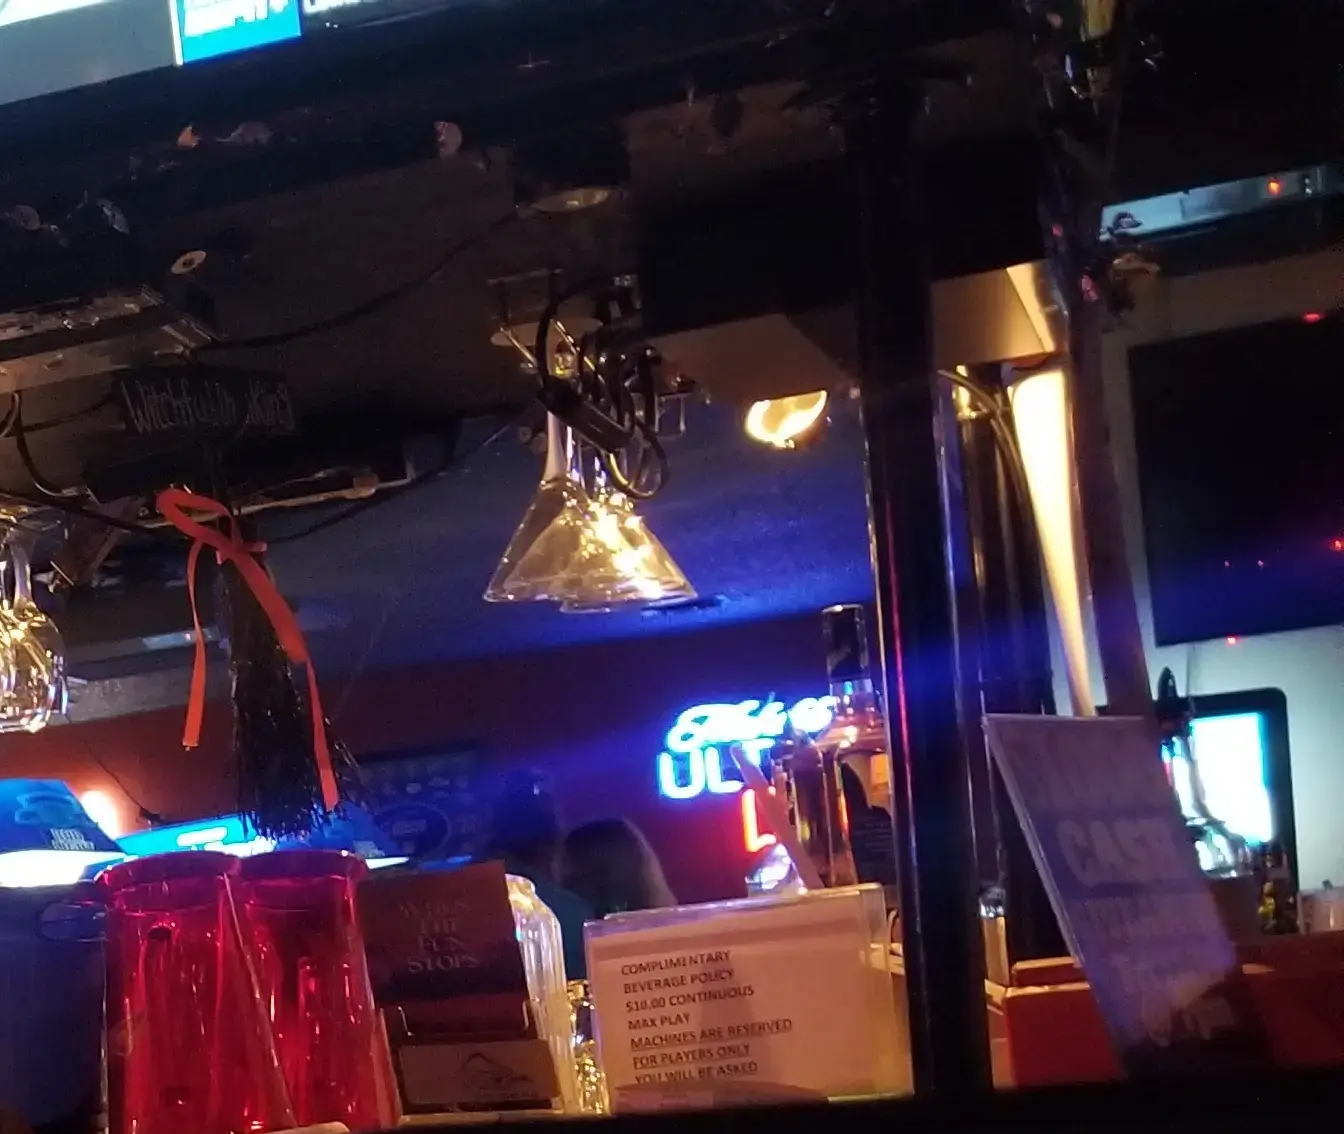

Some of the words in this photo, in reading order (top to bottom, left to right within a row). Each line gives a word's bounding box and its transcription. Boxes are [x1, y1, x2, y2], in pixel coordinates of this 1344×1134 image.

[656, 736, 776, 800] ULT
[621, 949, 731, 976] COMPLIMENTARY
[623, 974, 686, 994] BEVERAGE
[690, 968, 734, 986] POLICY
[625, 996, 666, 1014] $10.00
[668, 984, 754, 1007] CONTINUOUS
[627, 1017, 657, 1031] MAX
[660, 1011, 691, 1028] PLAY
[629, 1030, 696, 1049] MACHINES
[699, 1025, 724, 1041] ARE
[727, 1017, 793, 1037] RESERVED
[633, 1054, 658, 1070] FOR
[661, 1048, 713, 1065] PLAYERS
[716, 1042, 752, 1058] ONLY
[634, 1068, 662, 1085] YOU
[698, 1065, 712, 1079] BE
[715, 1060, 758, 1078] ASKED
